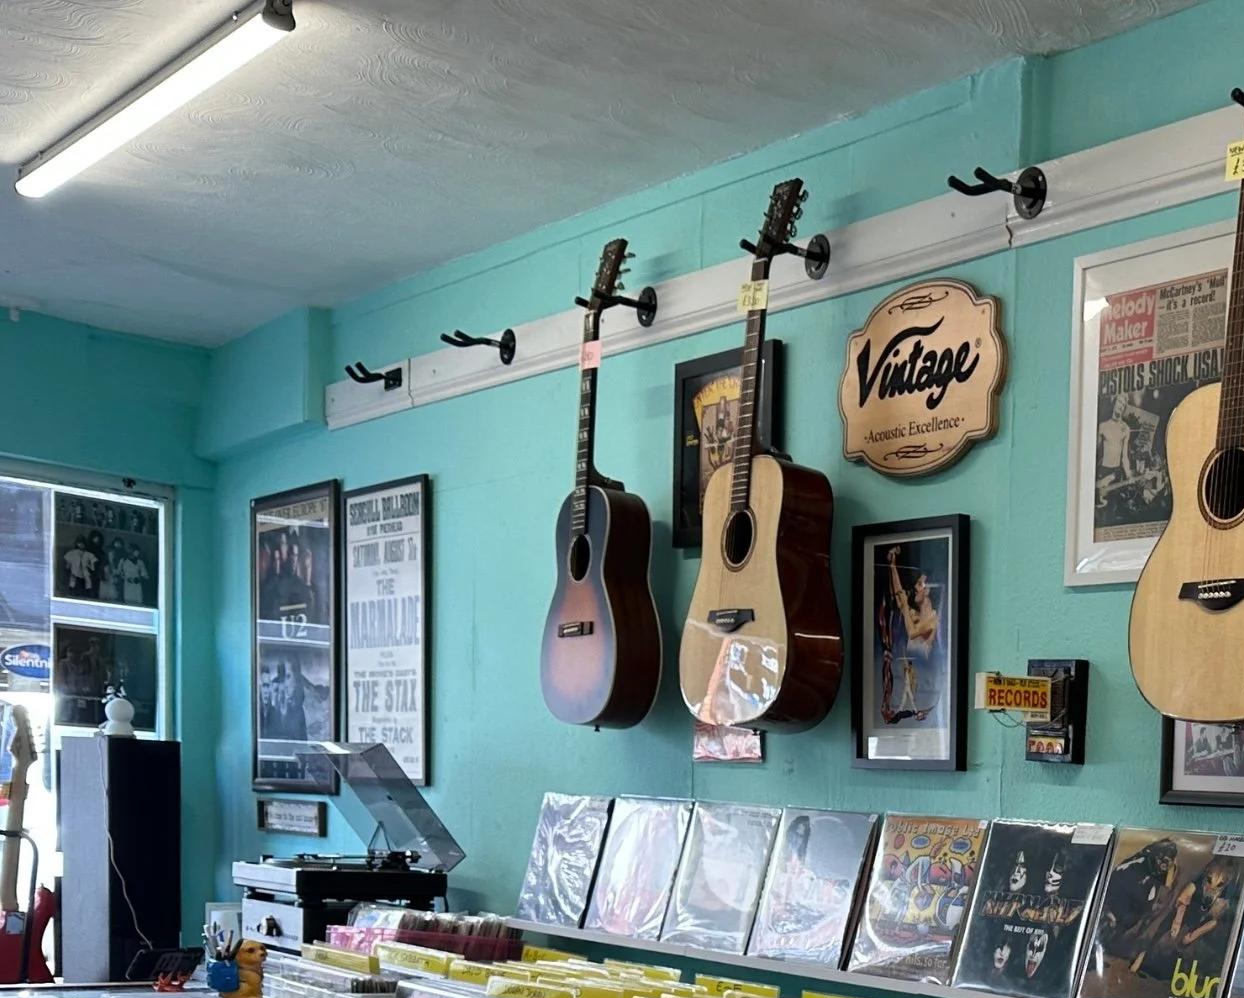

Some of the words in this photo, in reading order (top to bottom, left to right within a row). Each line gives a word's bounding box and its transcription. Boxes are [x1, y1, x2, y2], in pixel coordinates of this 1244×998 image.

[1160, 280, 1202, 300] McCartney's
[1103, 319, 1149, 345] Maker
[857, 316, 980, 411] Vintage
[1100, 362, 1145, 396] PISTOLS
[1149, 354, 1189, 389] SHOCK
[866, 427, 906, 444] Acoustic
[908, 416, 960, 437] Excellence
[376, 578, 395, 597] THE
[280, 613, 308, 639] U2
[350, 595, 420, 649] MARMALADE
[353, 679, 378, 713] THE
[384, 677, 418, 714] STAX
[988, 688, 1048, 708] RECORDS
[358, 727, 376, 743] THE
[381, 726, 415, 744] STACK
[923, 823, 960, 836] Image
[962, 825, 980, 838] Ltd
[1003, 924, 1013, 932] THE
[1013, 924, 1026, 934] BEST
[1026, 927, 1034, 935] OF
